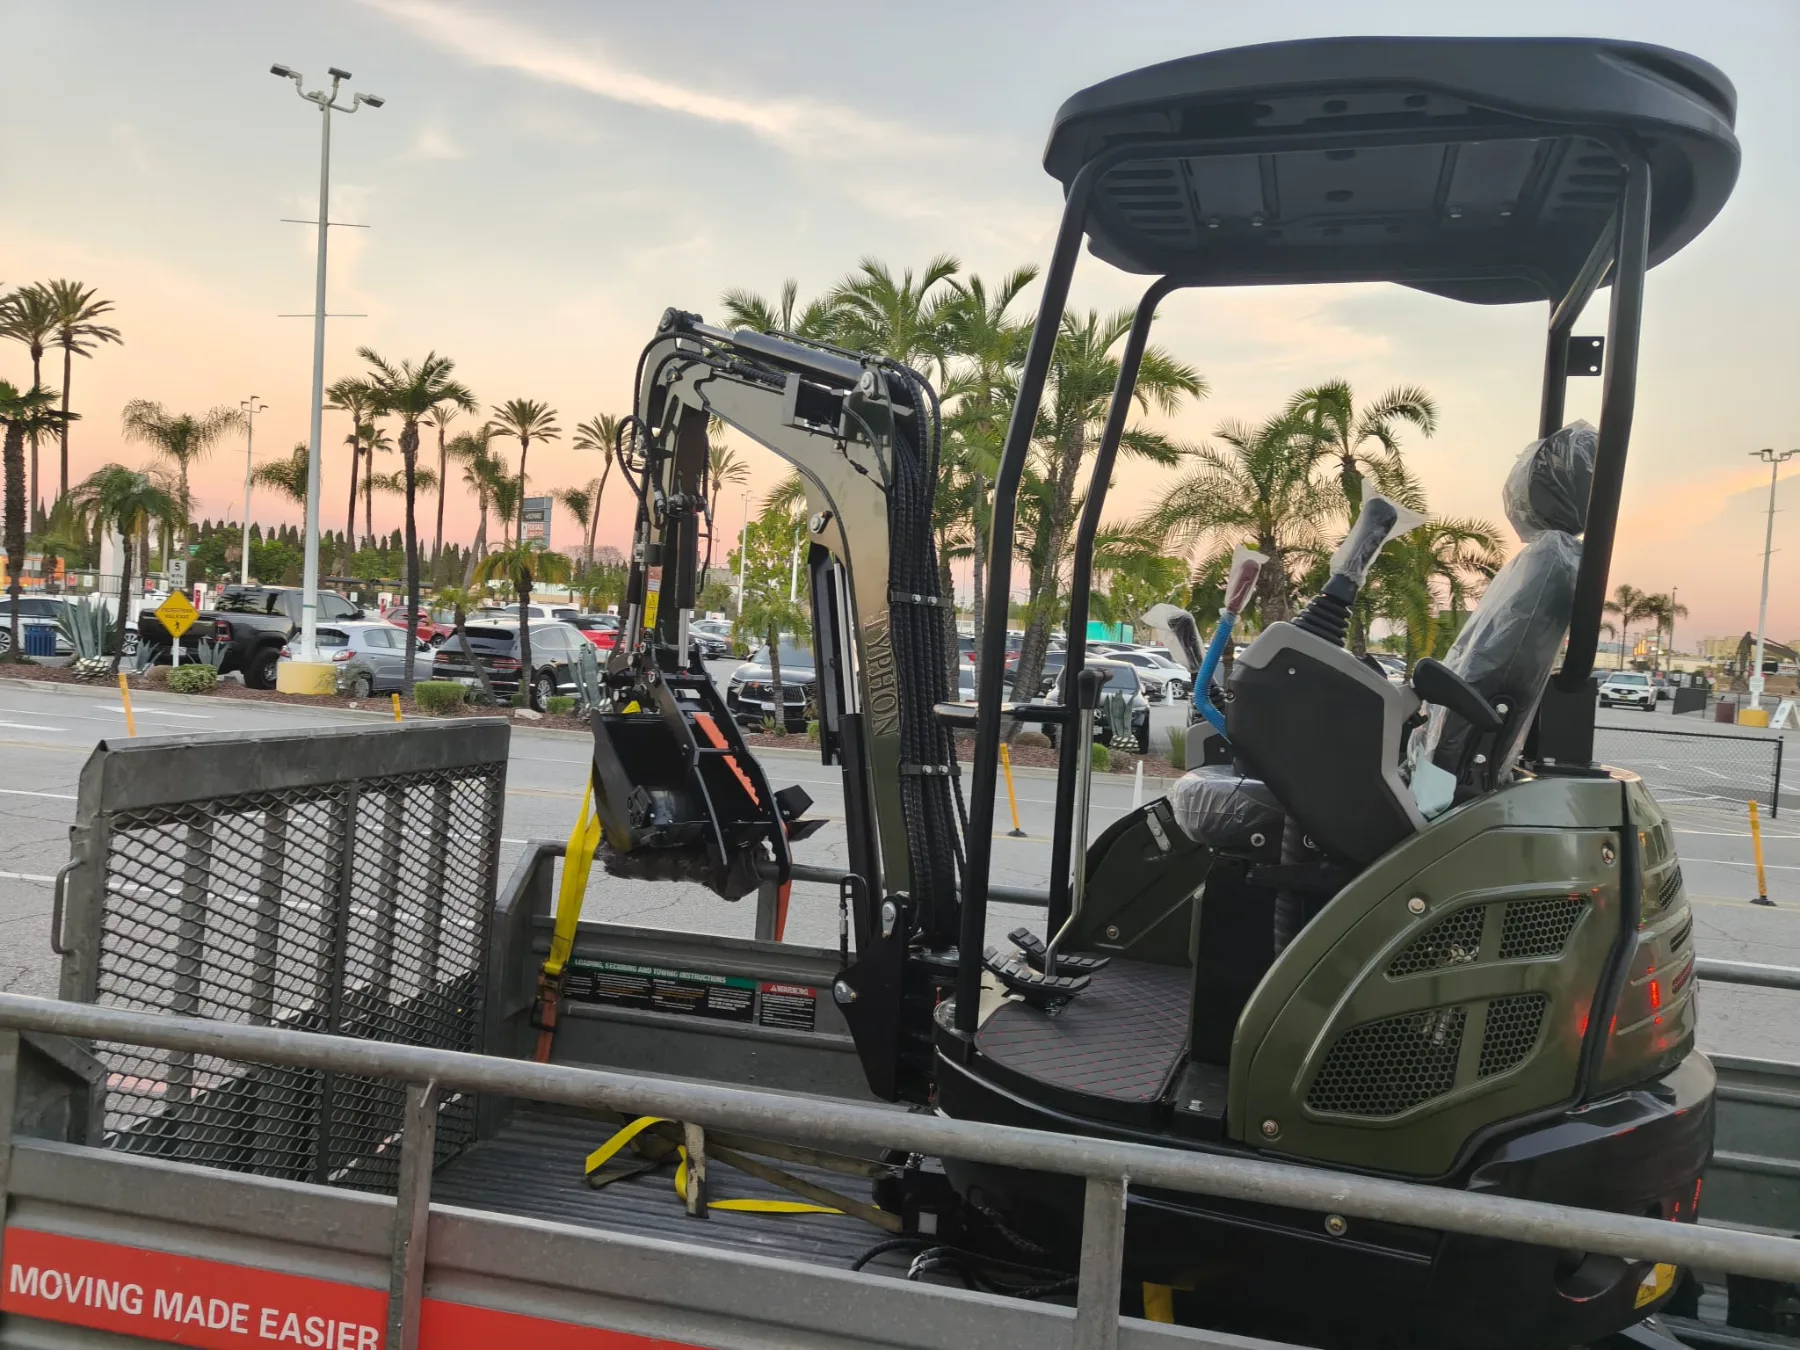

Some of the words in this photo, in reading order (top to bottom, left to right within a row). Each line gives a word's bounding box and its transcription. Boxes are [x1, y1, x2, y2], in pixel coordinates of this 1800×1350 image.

[174, 562, 181, 571] 5
[864, 610, 899, 737] TYPHON
[604, 962, 637, 972] SECURING
[653, 968, 679, 977] TOWING
[679, 971, 727, 984] INSTRUCTIONS
[777, 985, 809, 995] WARNING
[9, 1263, 144, 1315] MOVING
[153, 1288, 250, 1334] MADE
[259, 1307, 379, 1350] EASIER
